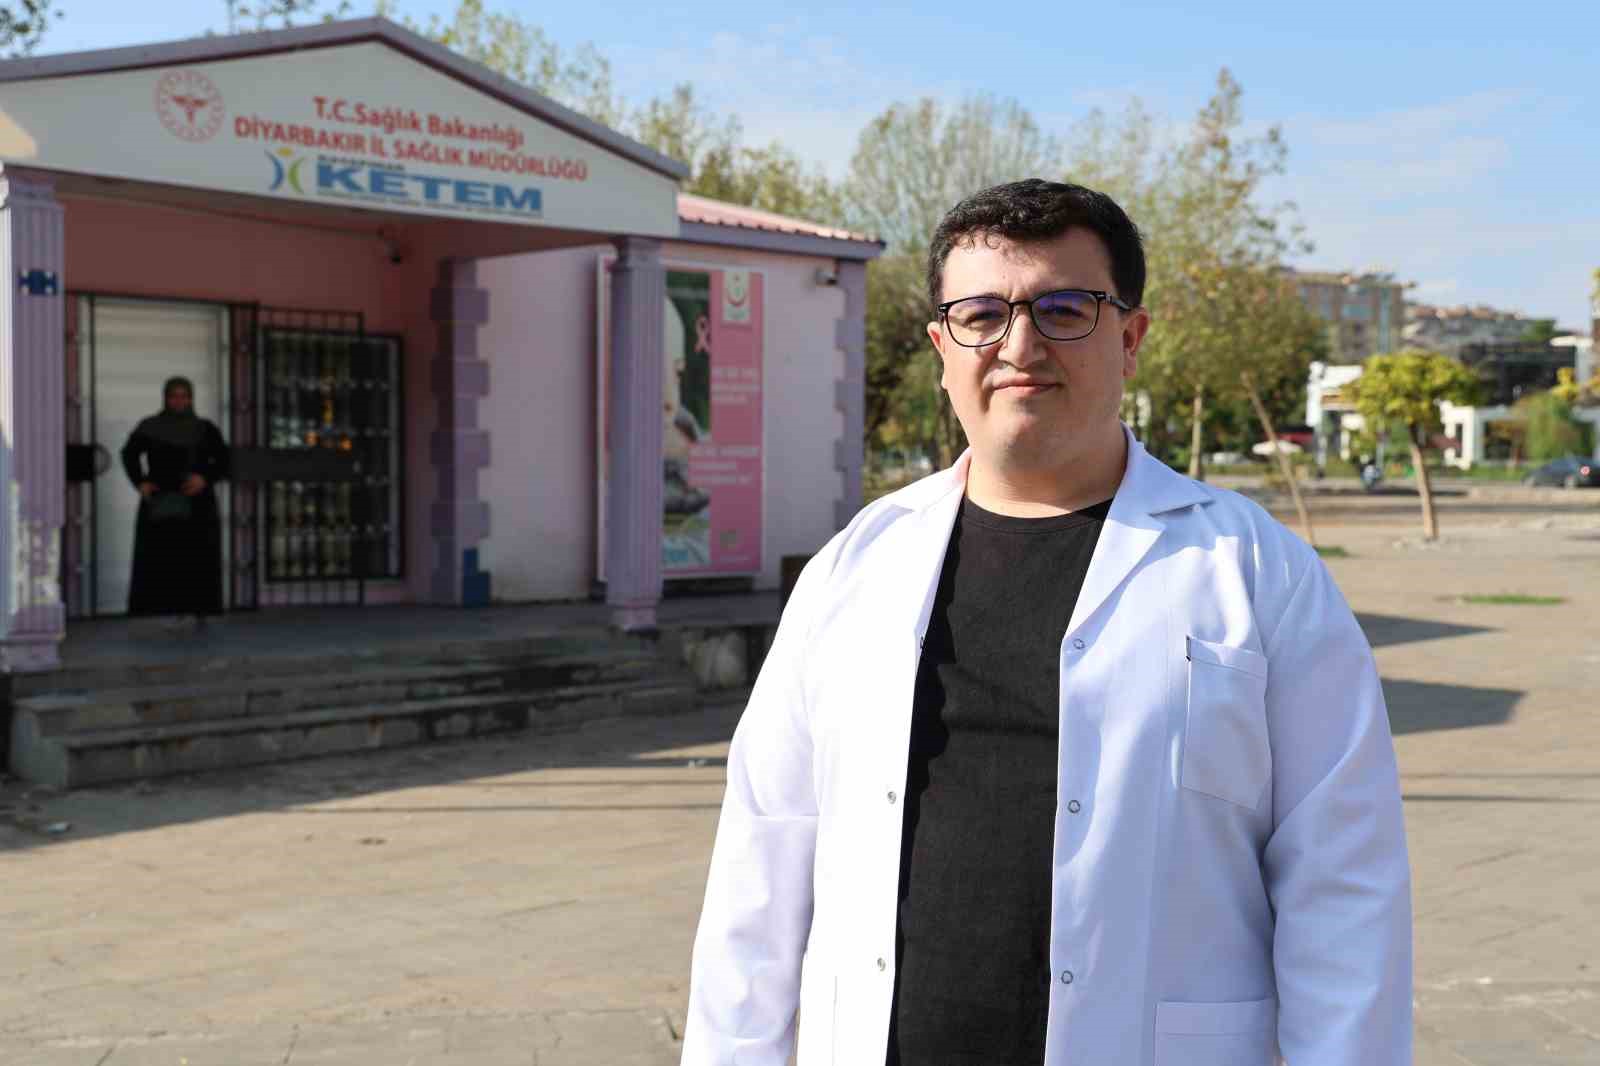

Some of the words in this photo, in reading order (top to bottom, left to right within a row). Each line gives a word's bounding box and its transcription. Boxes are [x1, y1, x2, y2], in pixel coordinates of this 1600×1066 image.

[234, 115, 367, 153] DİYARBAKIR
[369, 133, 388, 158] İL
[392, 138, 465, 165] SAĞLIK
[467, 147, 588, 180] MÜDÜRLÜĞÜ
[427, 109, 524, 149] Bakanlığı
[317, 163, 542, 211] KETEM
